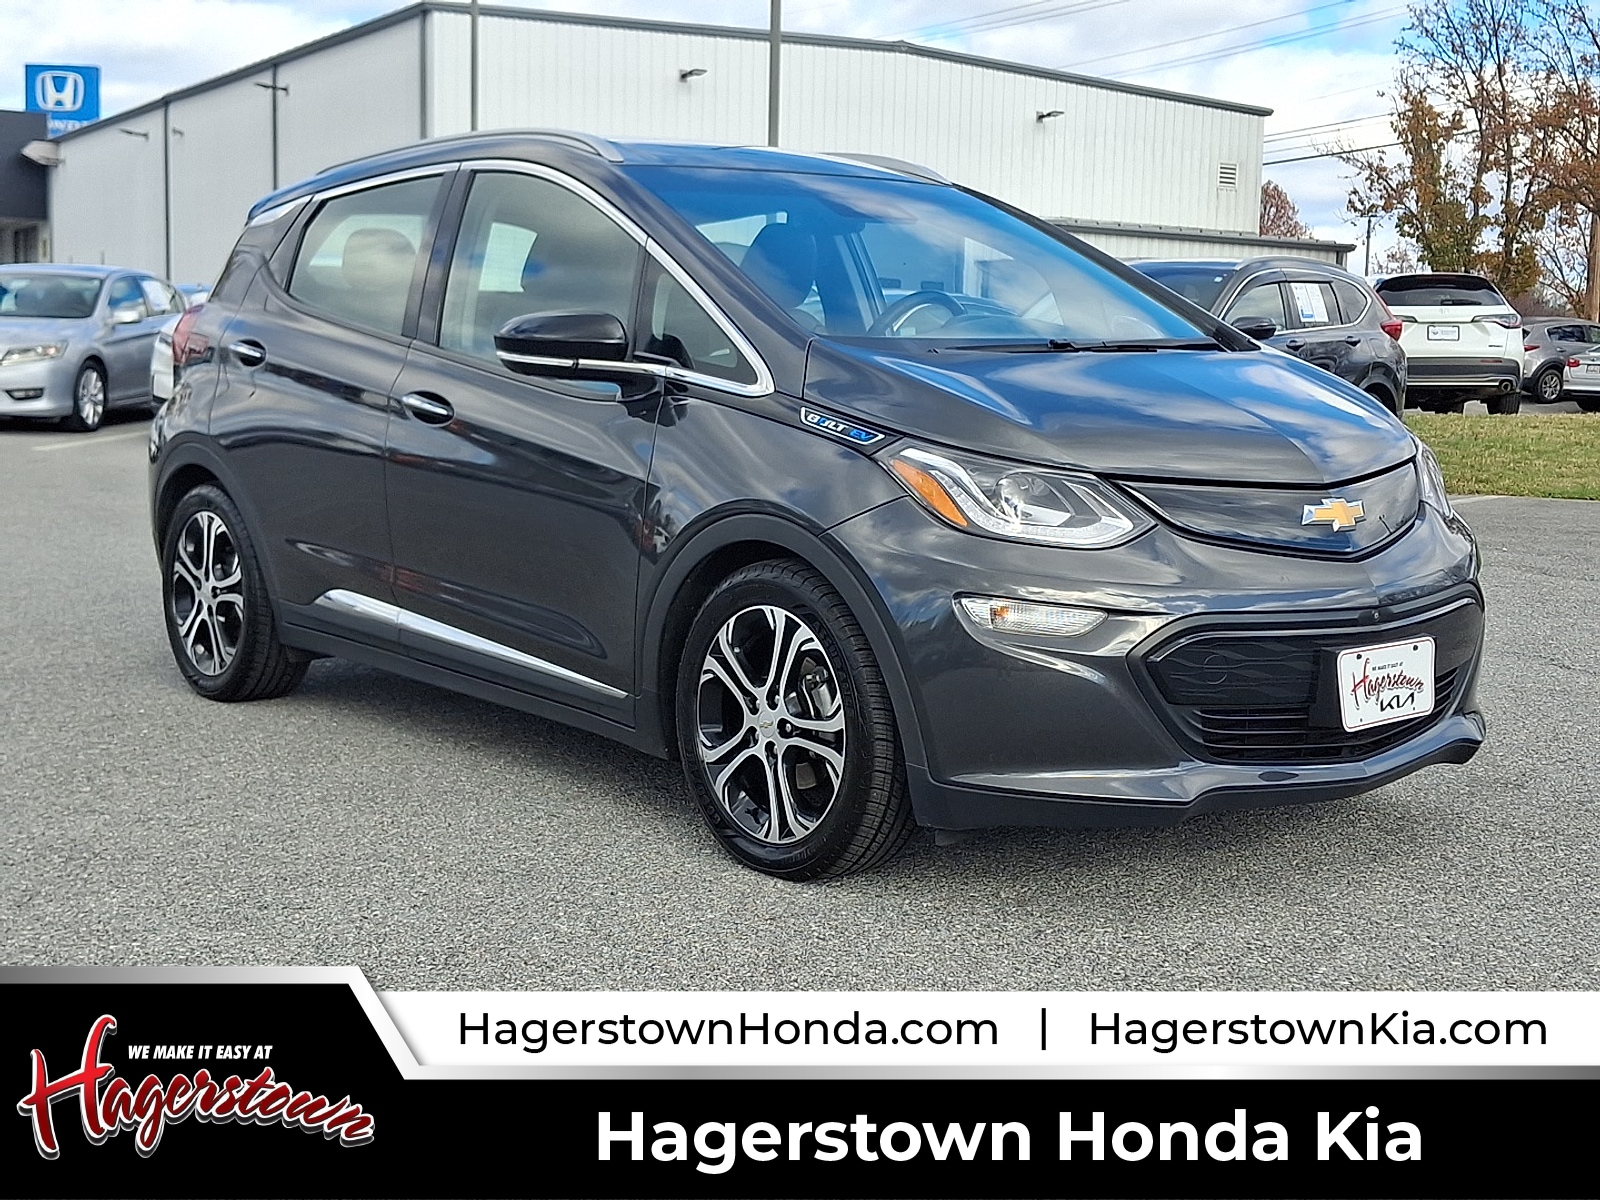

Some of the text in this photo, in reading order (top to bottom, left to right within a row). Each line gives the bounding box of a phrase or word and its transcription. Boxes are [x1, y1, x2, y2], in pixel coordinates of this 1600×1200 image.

[806, 413, 874, 441] BOLT EV
[1350, 657, 1424, 711] Hagerstown
